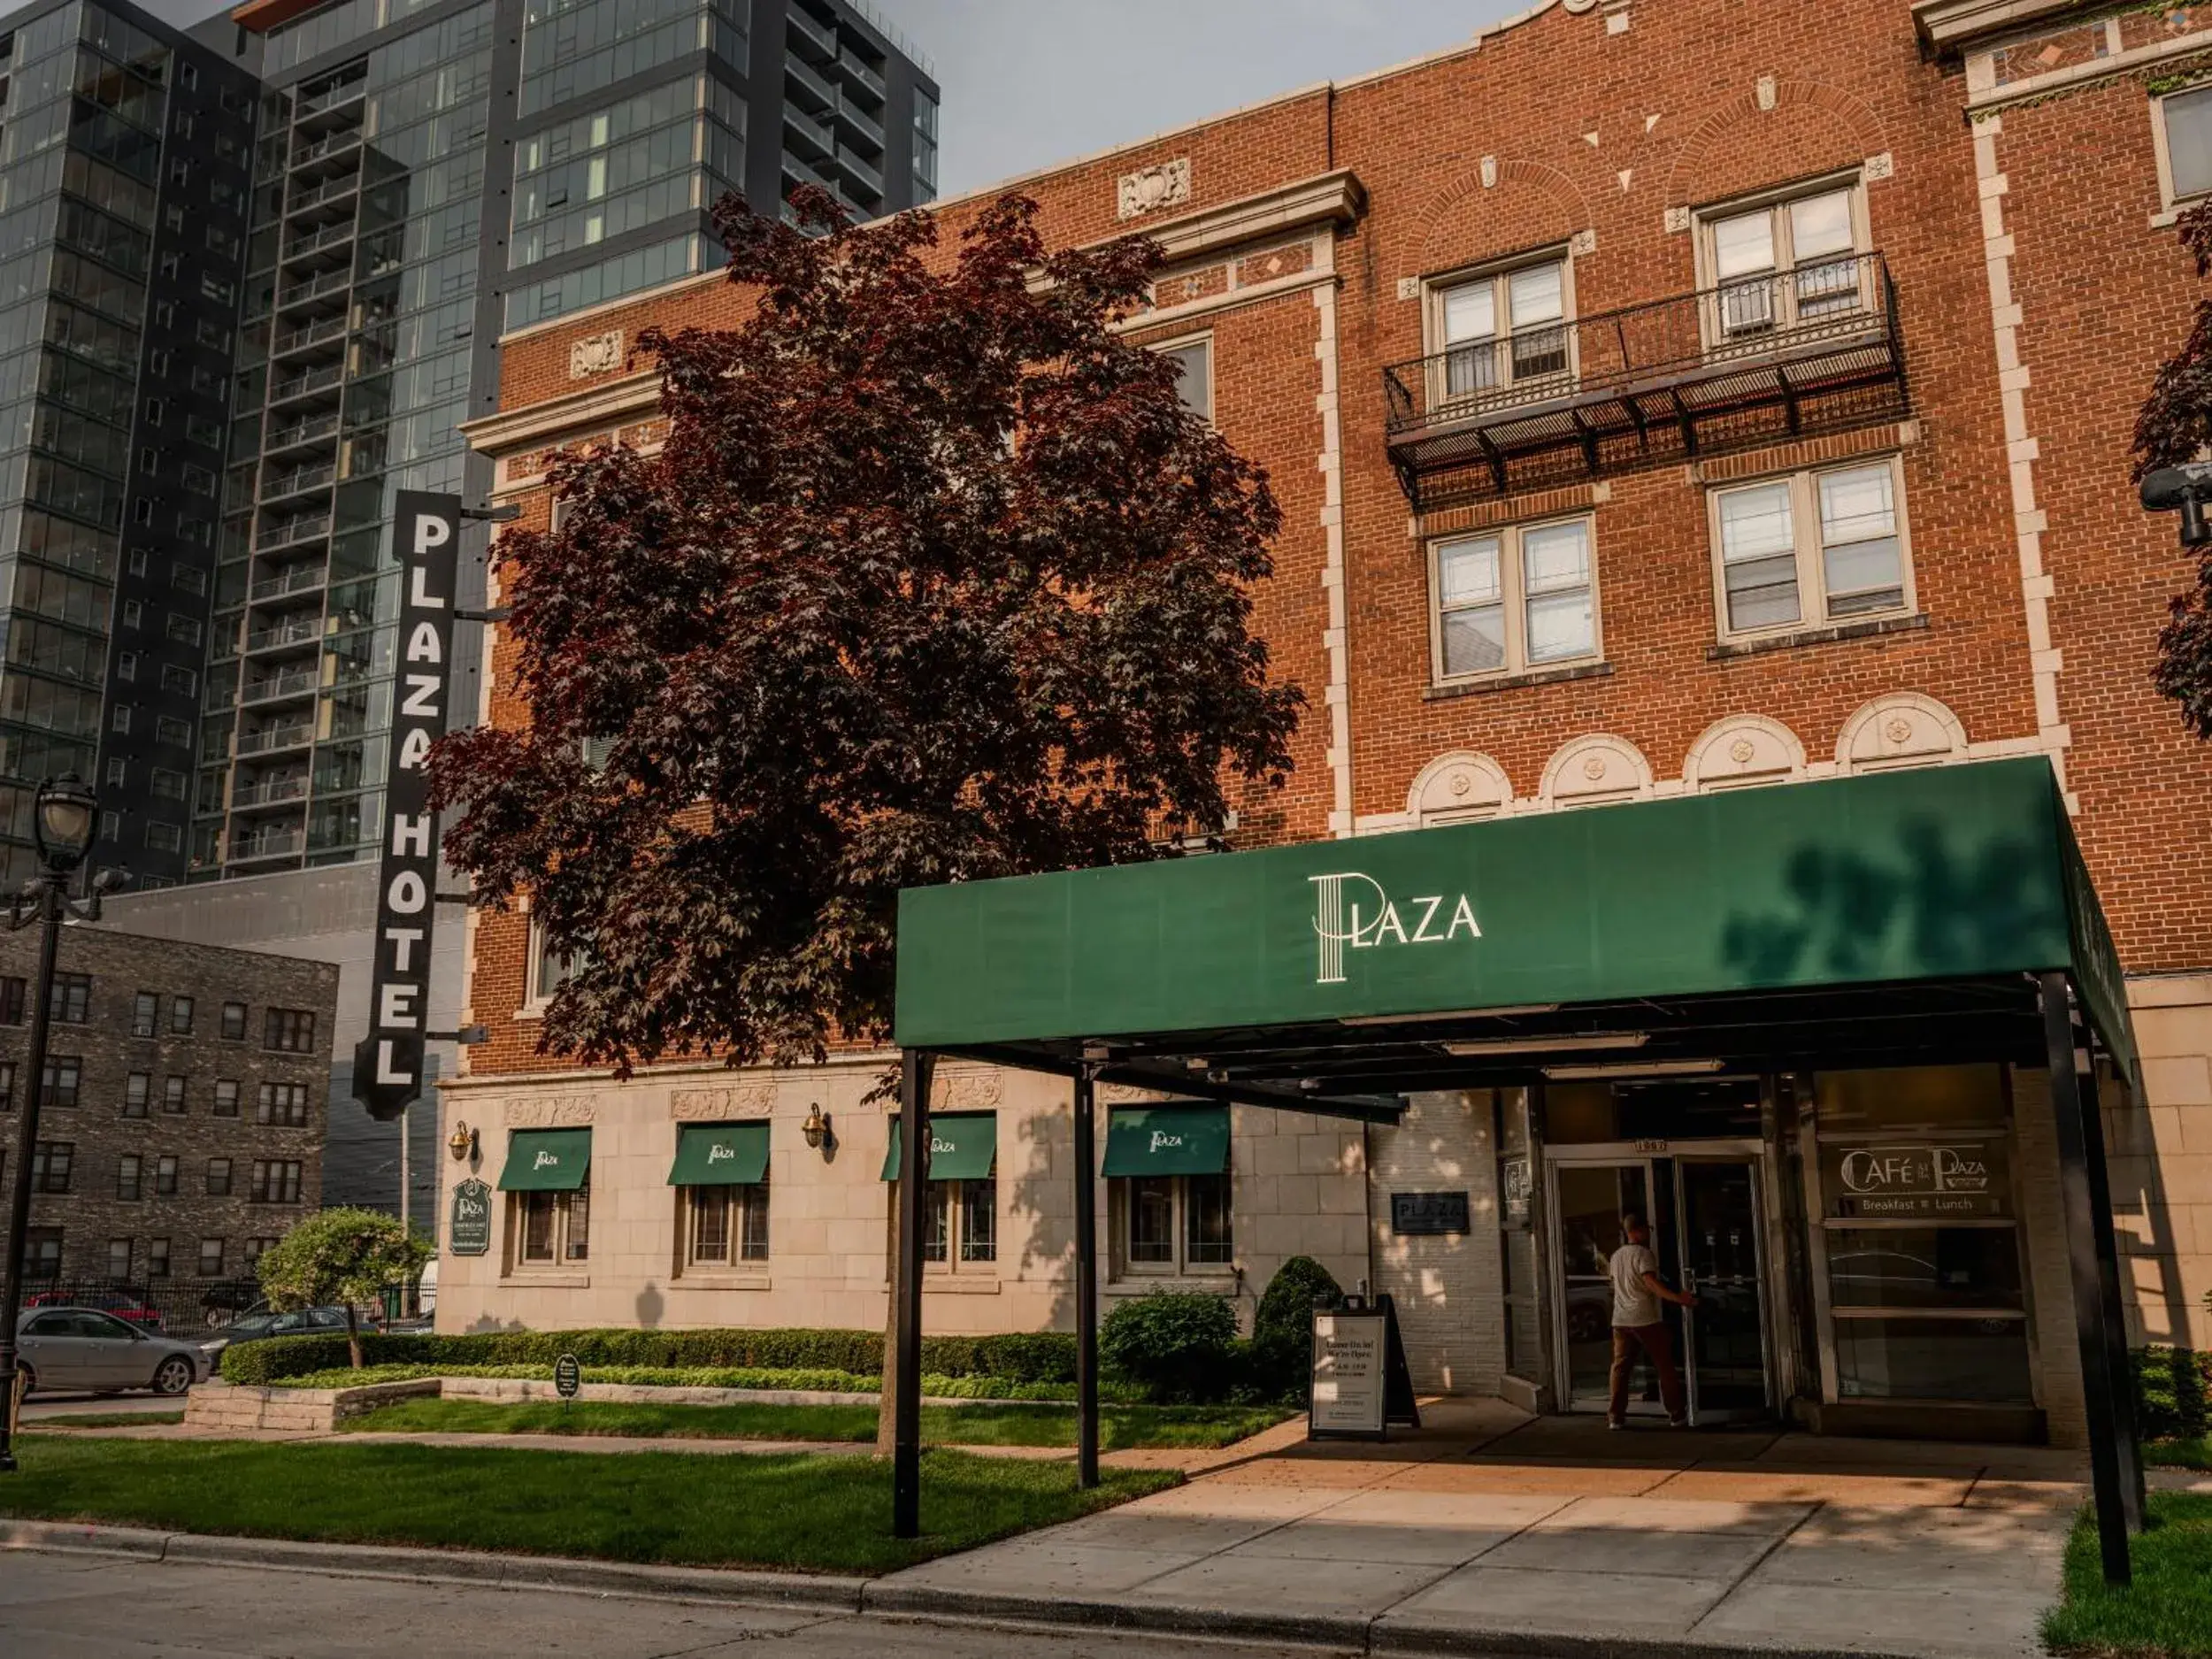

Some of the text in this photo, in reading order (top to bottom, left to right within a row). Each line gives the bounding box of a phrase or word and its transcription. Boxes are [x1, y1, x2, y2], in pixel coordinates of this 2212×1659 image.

[376, 514, 449, 1087] PLAZA HOTEL
[1308, 872, 1482, 984] PLAZA
[1149, 1130, 1182, 1152] PLAZA
[533, 1150, 557, 1170] PLAZA
[708, 1141, 733, 1164] PLAZA
[1932, 1148, 1986, 1191] PLAZA
[459, 1198, 484, 1220] PLAZA
[1400, 1202, 1461, 1217] PLAZA
[1863, 1197, 1972, 1211] Breakfast Lunch
